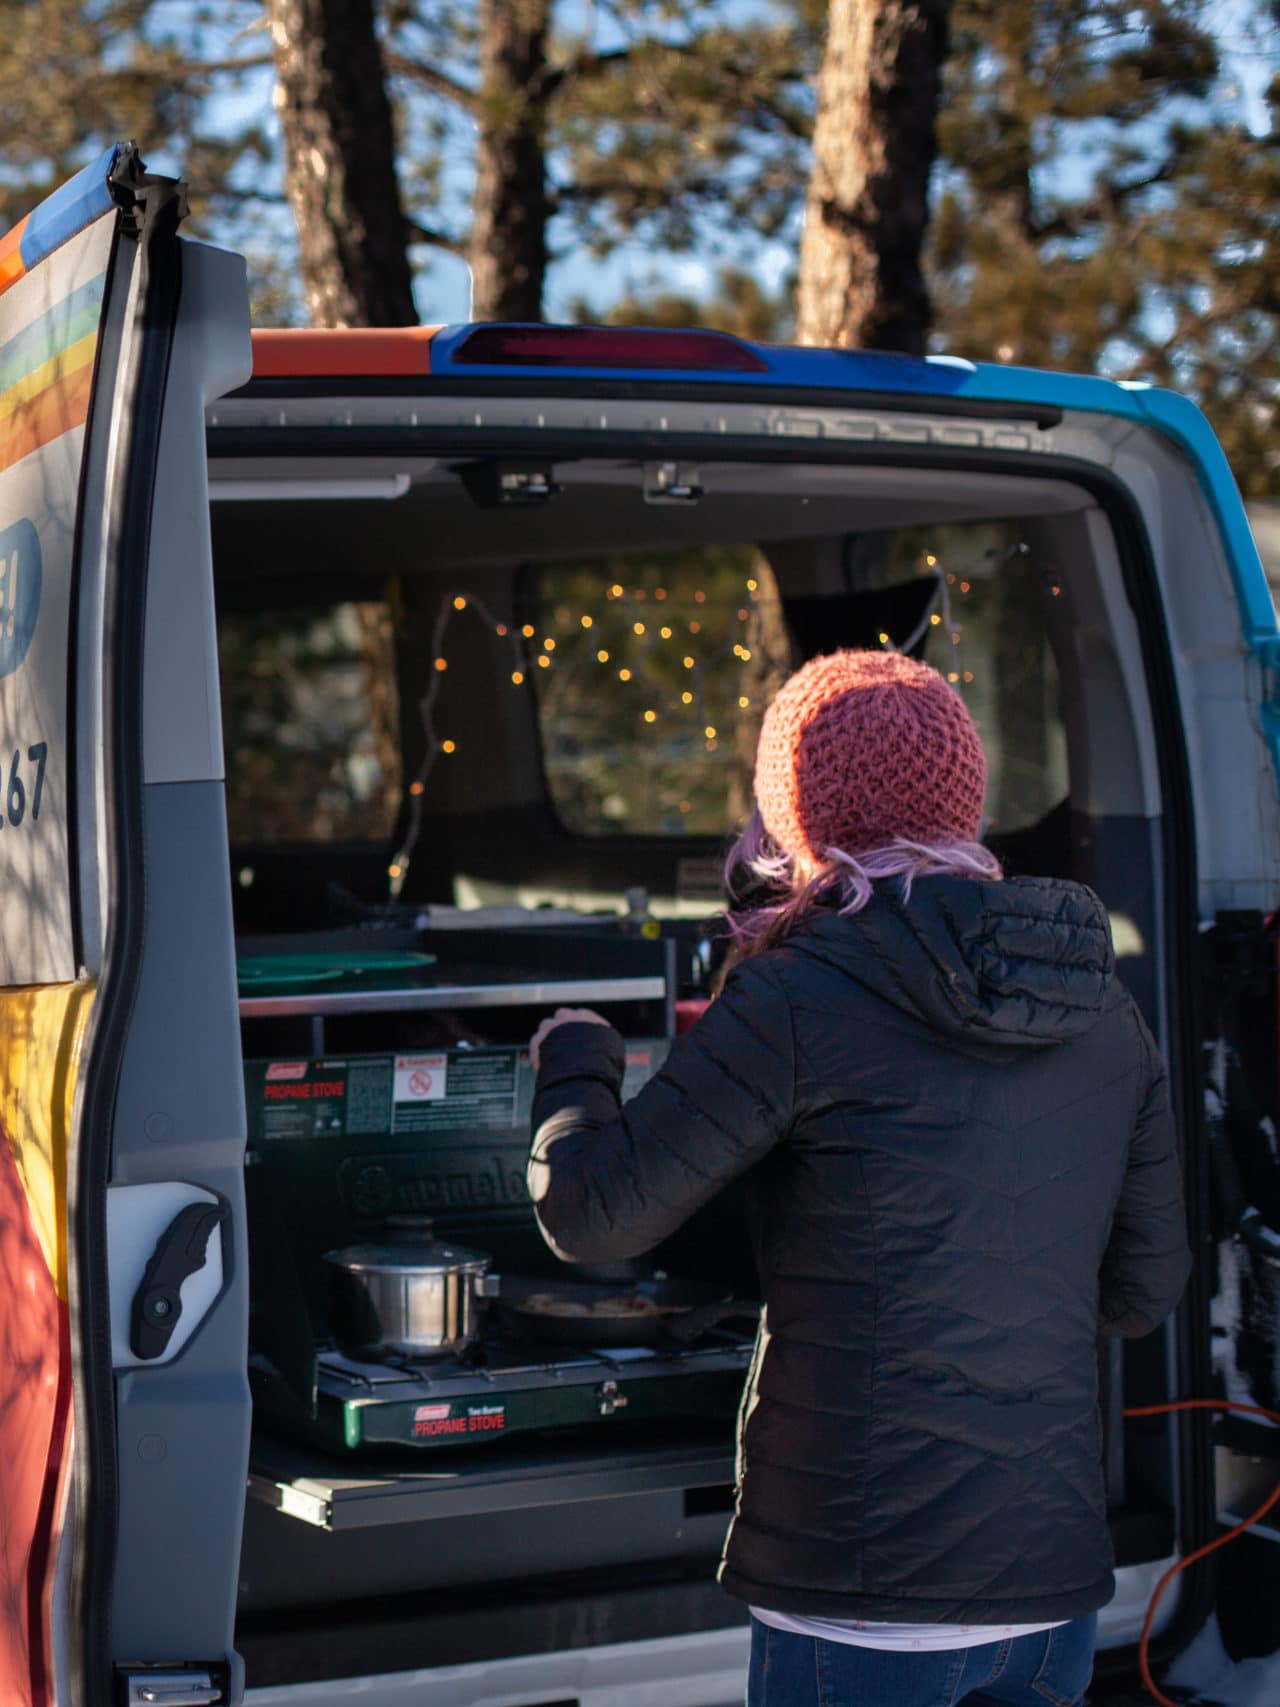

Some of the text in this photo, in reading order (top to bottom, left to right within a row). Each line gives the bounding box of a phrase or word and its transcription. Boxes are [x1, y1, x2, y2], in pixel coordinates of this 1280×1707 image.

[264, 1081, 344, 1099] PROPANE STOVE
[415, 1414, 504, 1435] PROPANE STOVE
